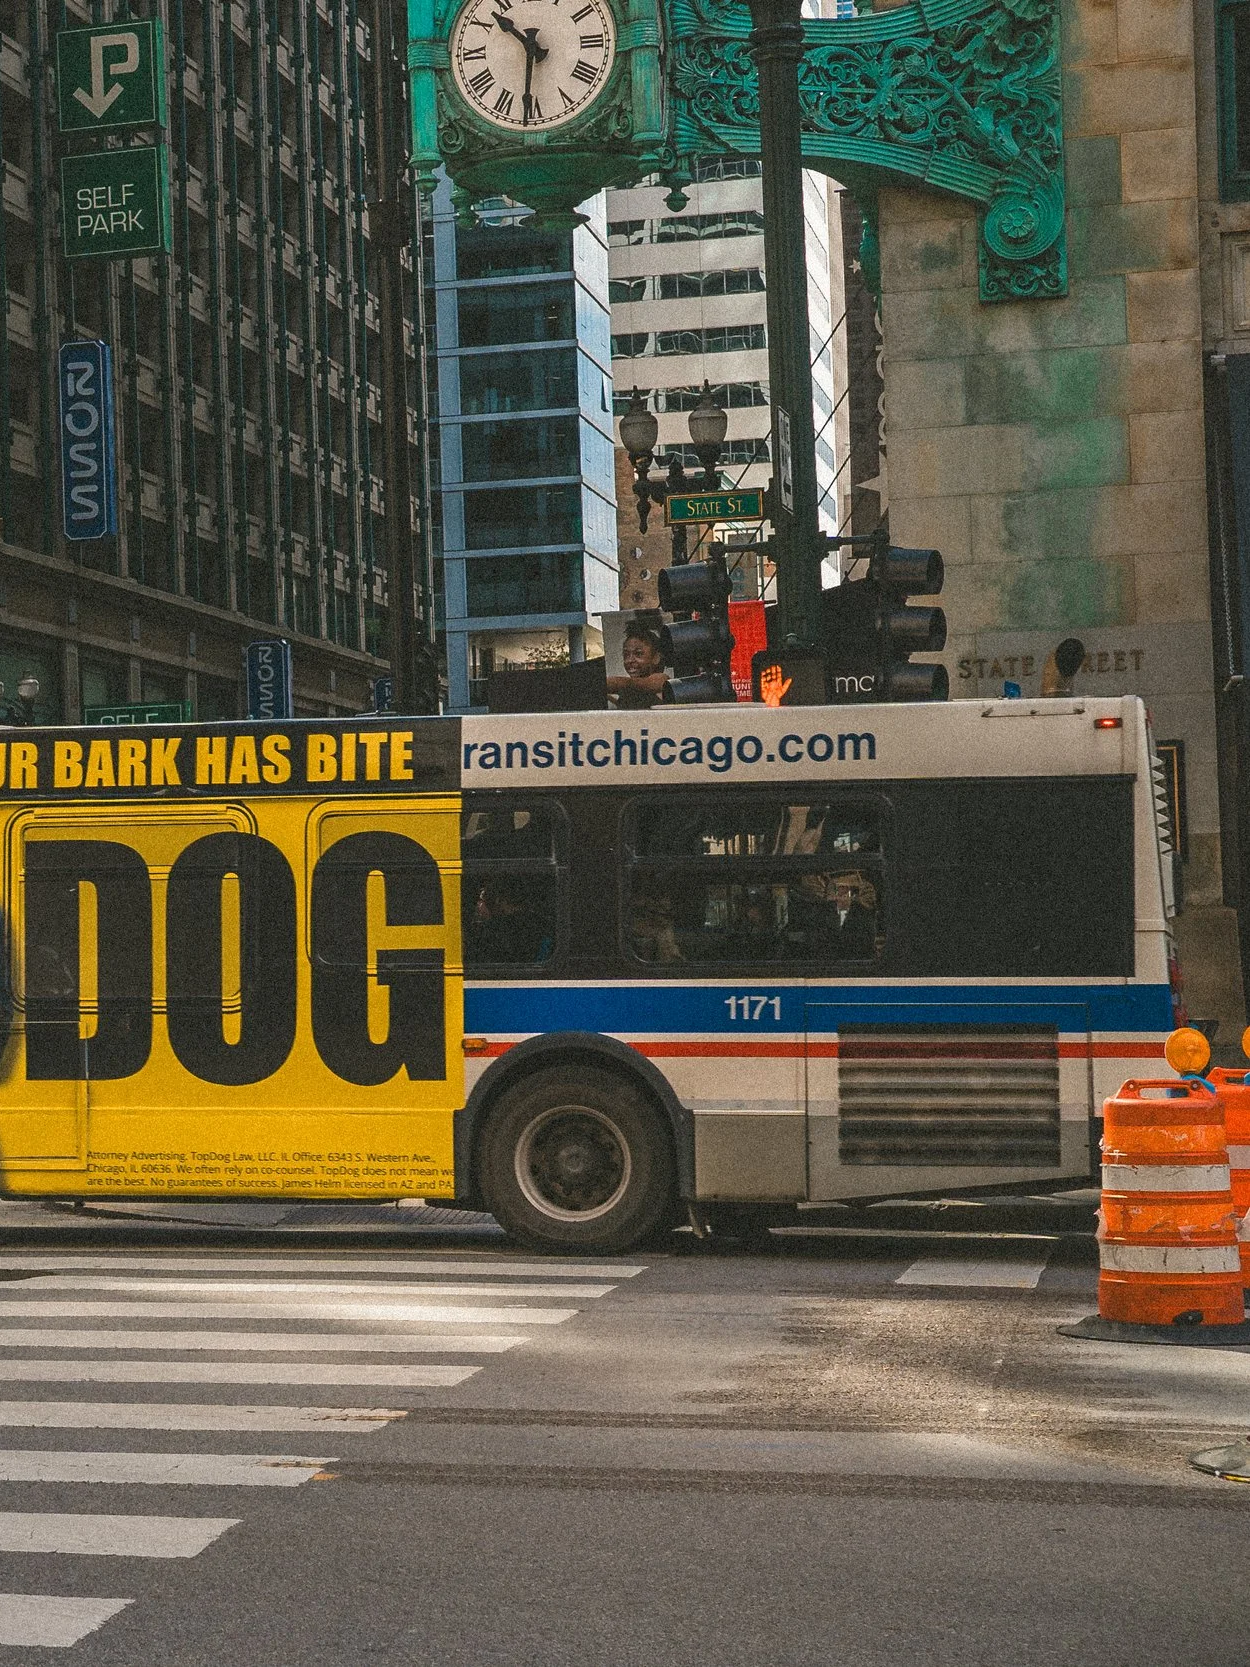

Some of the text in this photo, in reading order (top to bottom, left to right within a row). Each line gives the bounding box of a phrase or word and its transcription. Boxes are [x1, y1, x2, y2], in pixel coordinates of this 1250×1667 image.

[76, 183, 135, 211] SELF
[77, 209, 145, 237] PARK
[65, 361, 99, 520] ROSS
[687, 499, 722, 516] STATE
[957, 649, 1145, 679] STATE REET
[258, 646, 274, 719] ROSS
[54, 737, 182, 788] BARK
[195, 734, 291, 785] HAS
[306, 731, 413, 782] BITE
[463, 729, 876, 773] ransitchicago.com
[24, 830, 448, 1087] DOG
[724, 995, 781, 1020] 1171
[87, 1151, 128, 1162] Attorney
[131, 1151, 187, 1163] Advertising.
[191, 1152, 230, 1163] TopDog
[281, 1152, 290, 1161] IL
[328, 1152, 352, 1162] 6343
[367, 1153, 409, 1163] Western
[130, 1164, 138, 1173] IL
[176, 1164, 192, 1174] We
[195, 1164, 220, 1174] often
[224, 1165, 242, 1177] rely
[320, 1166, 359, 1177] TopDog
[362, 1166, 387, 1176] does
[389, 1167, 406, 1176] not
[410, 1168, 438, 1176] mean
[87, 1178, 103, 1186] are
[106, 1177, 121, 1186] the
[124, 1177, 147, 1186] best.
[150, 1177, 164, 1186] No
[167, 1178, 222, 1189] guarantees
[226, 1178, 237, 1187] of
[281, 1179, 312, 1189] James
[315, 1179, 341, 1188] Helm
[344, 1179, 384, 1189] licensed
[388, 1180, 397, 1188] in
[401, 1180, 414, 1189] AZ
[416, 1180, 435, 1190] and
